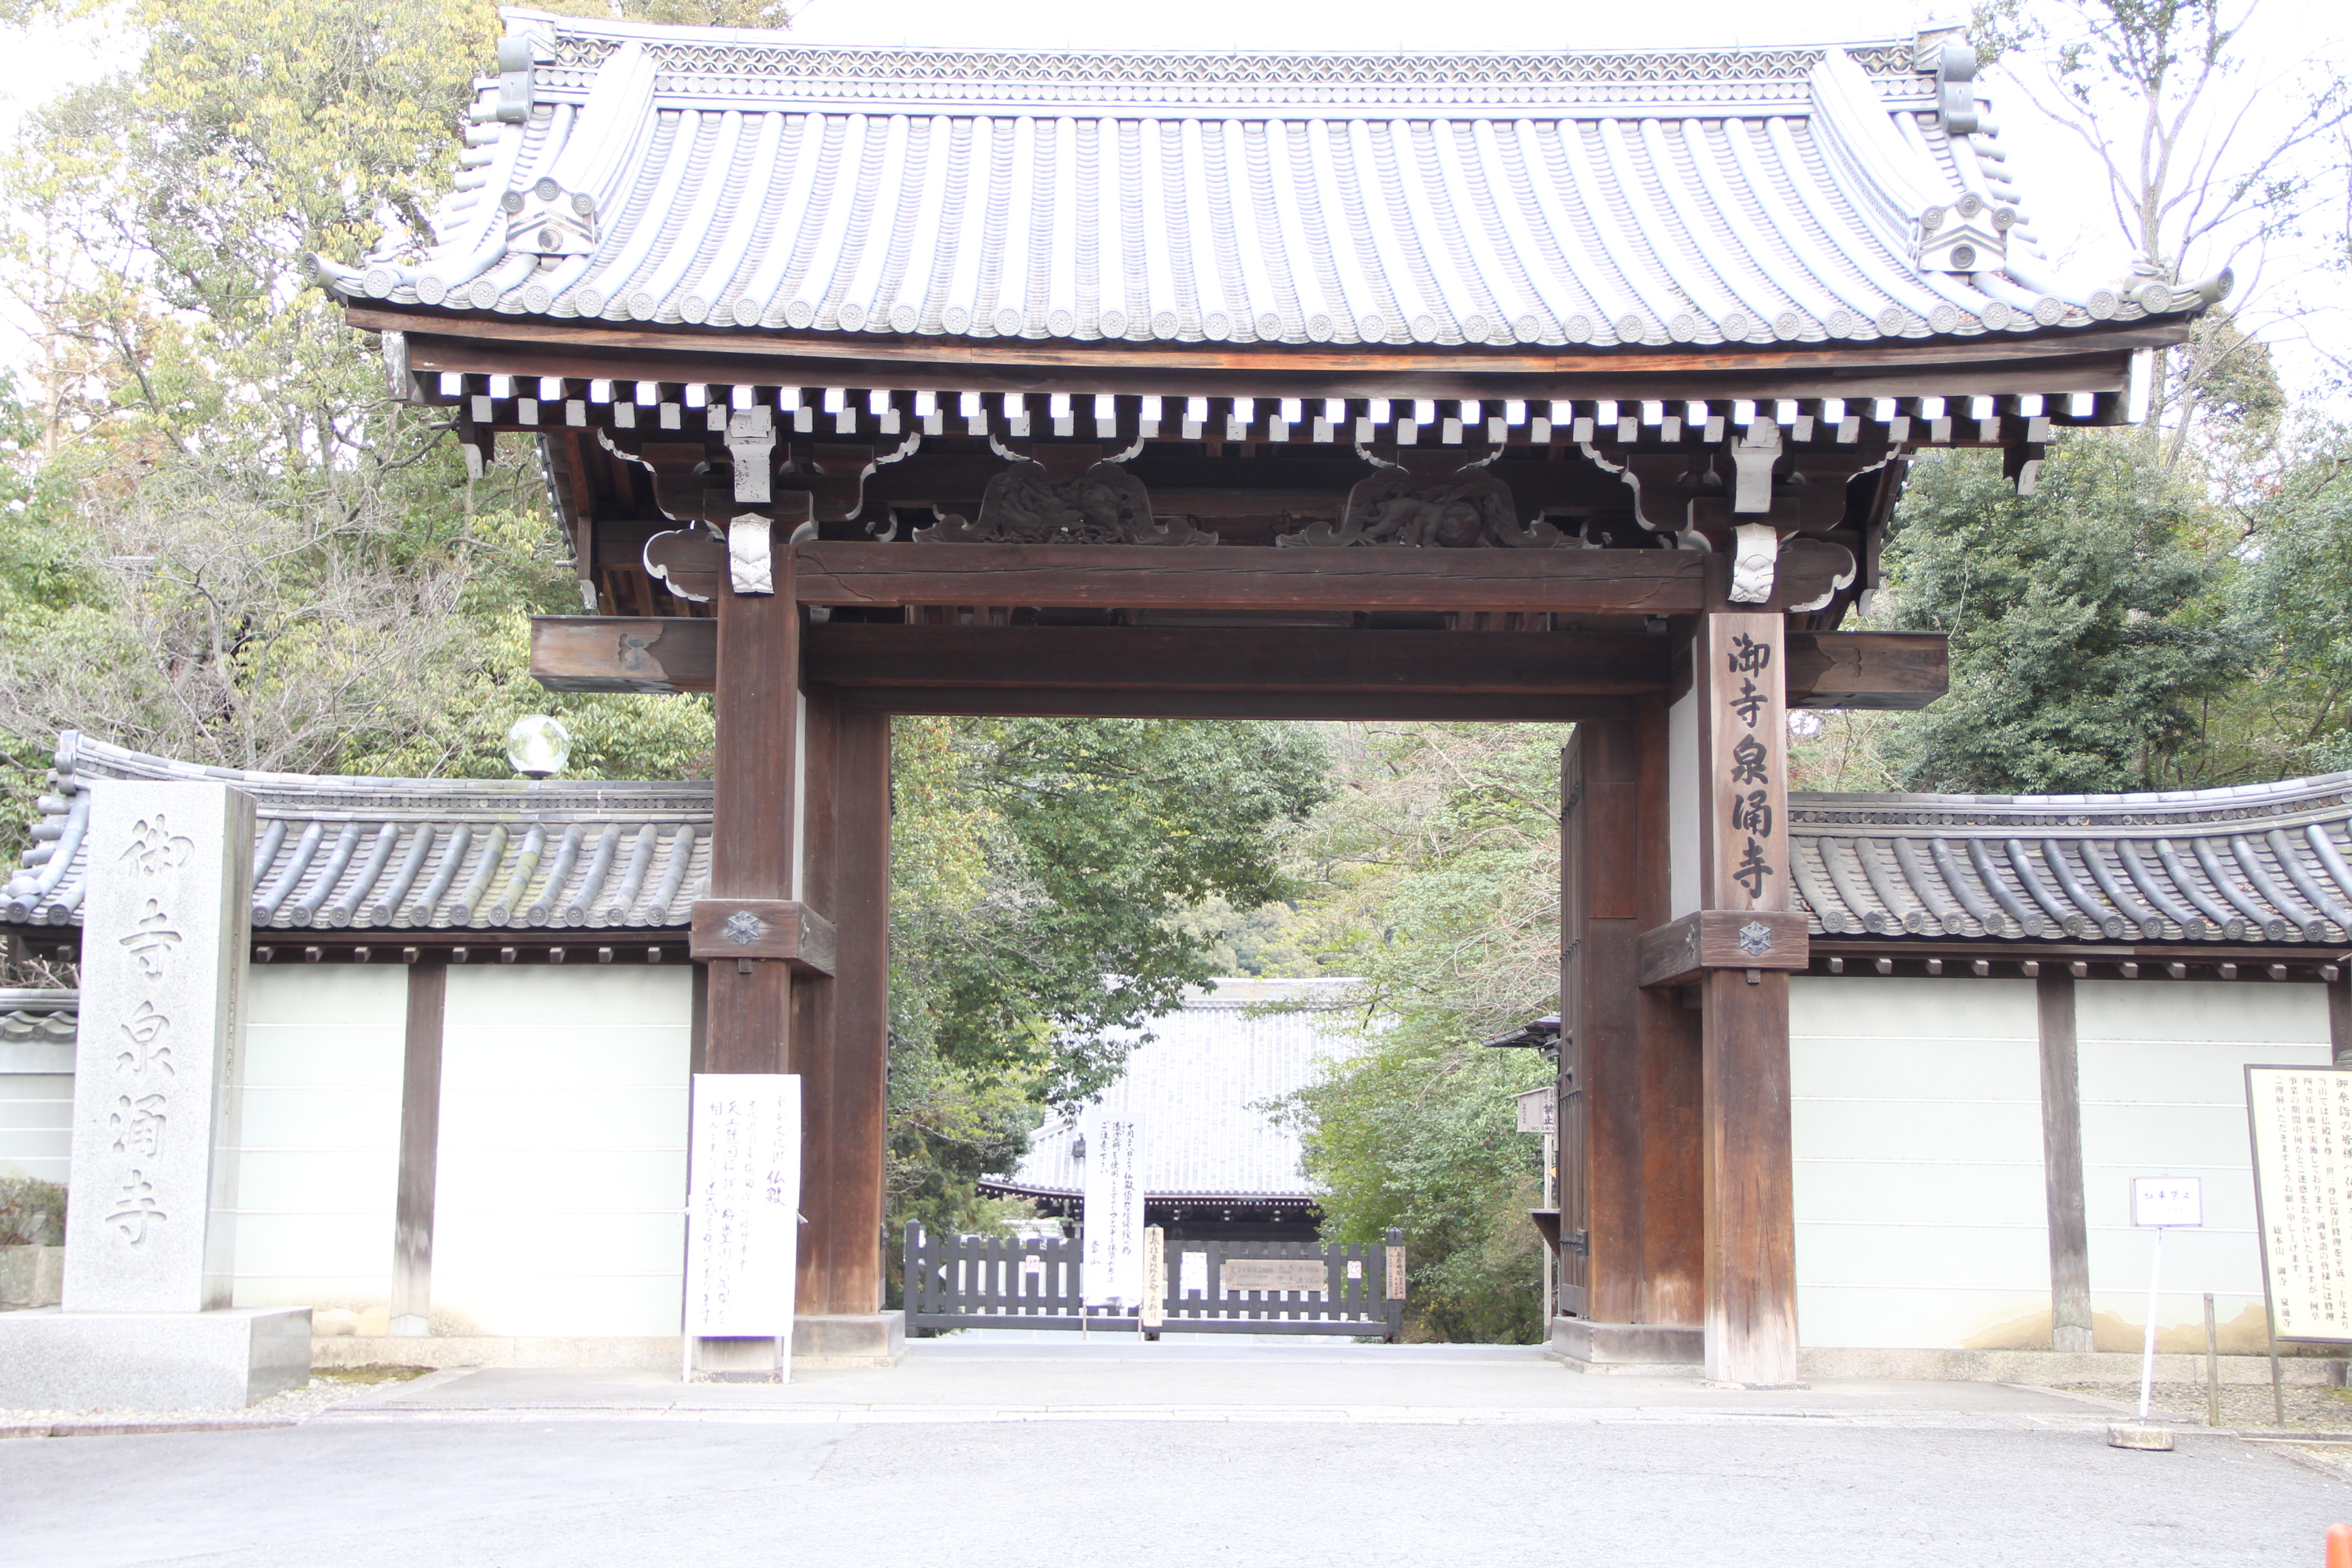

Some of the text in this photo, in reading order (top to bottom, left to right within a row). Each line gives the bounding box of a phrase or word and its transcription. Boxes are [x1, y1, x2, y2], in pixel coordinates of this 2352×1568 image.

[1727, 632, 1774, 899] 御寺泉涌寺
[105, 813, 196, 1247] 御寺泉涌寺
[1099, 1120, 1111, 1174] ご注意下さい
[1543, 1104, 1554, 1125] 禁止
[764, 1170, 787, 1206] 仏殿
[2143, 1190, 2191, 1200] 駐車禁止
[2274, 1075, 2302, 1279] ご理解いただきますようお願い申し上げます。
[2273, 1226, 2291, 1328] 総本山 御寺 泉涌寺
